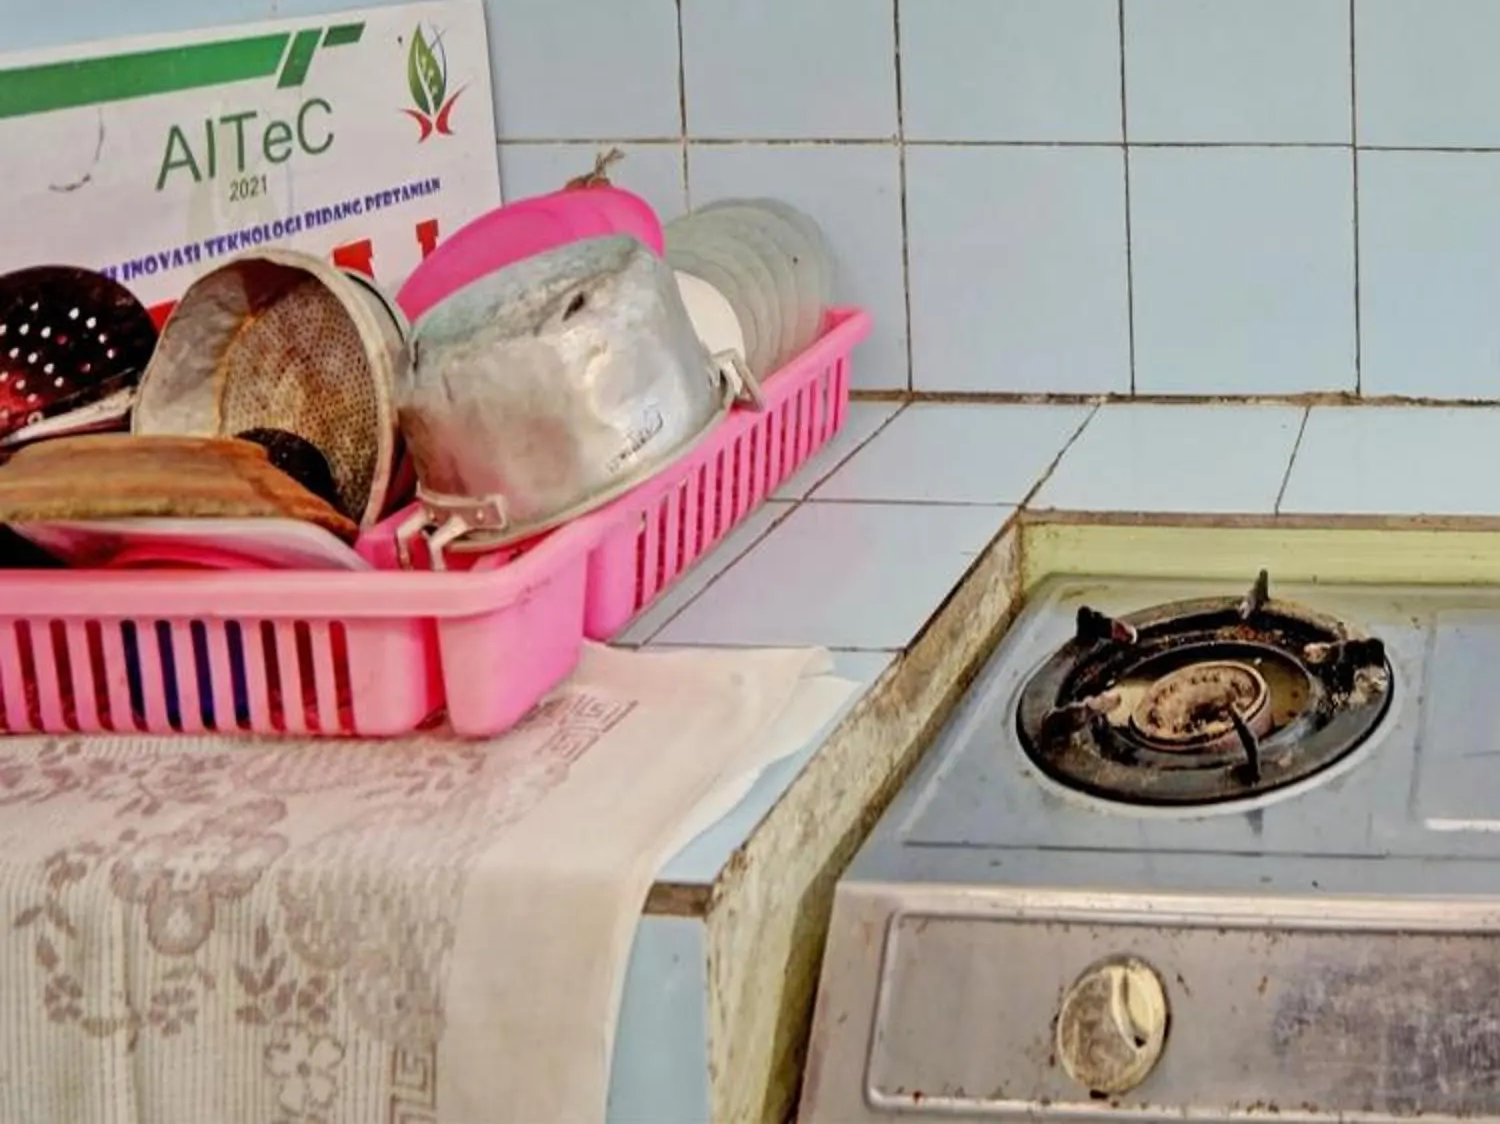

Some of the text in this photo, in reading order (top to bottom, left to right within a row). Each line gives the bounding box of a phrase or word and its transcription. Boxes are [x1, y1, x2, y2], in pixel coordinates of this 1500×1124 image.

[229, 174, 268, 202] 2021
[121, 242, 201, 282] INOVASI
[204, 215, 302, 258] TEKNOLOGI
[304, 197, 362, 230] BIDANG
[364, 176, 441, 212] PERTANIAN
